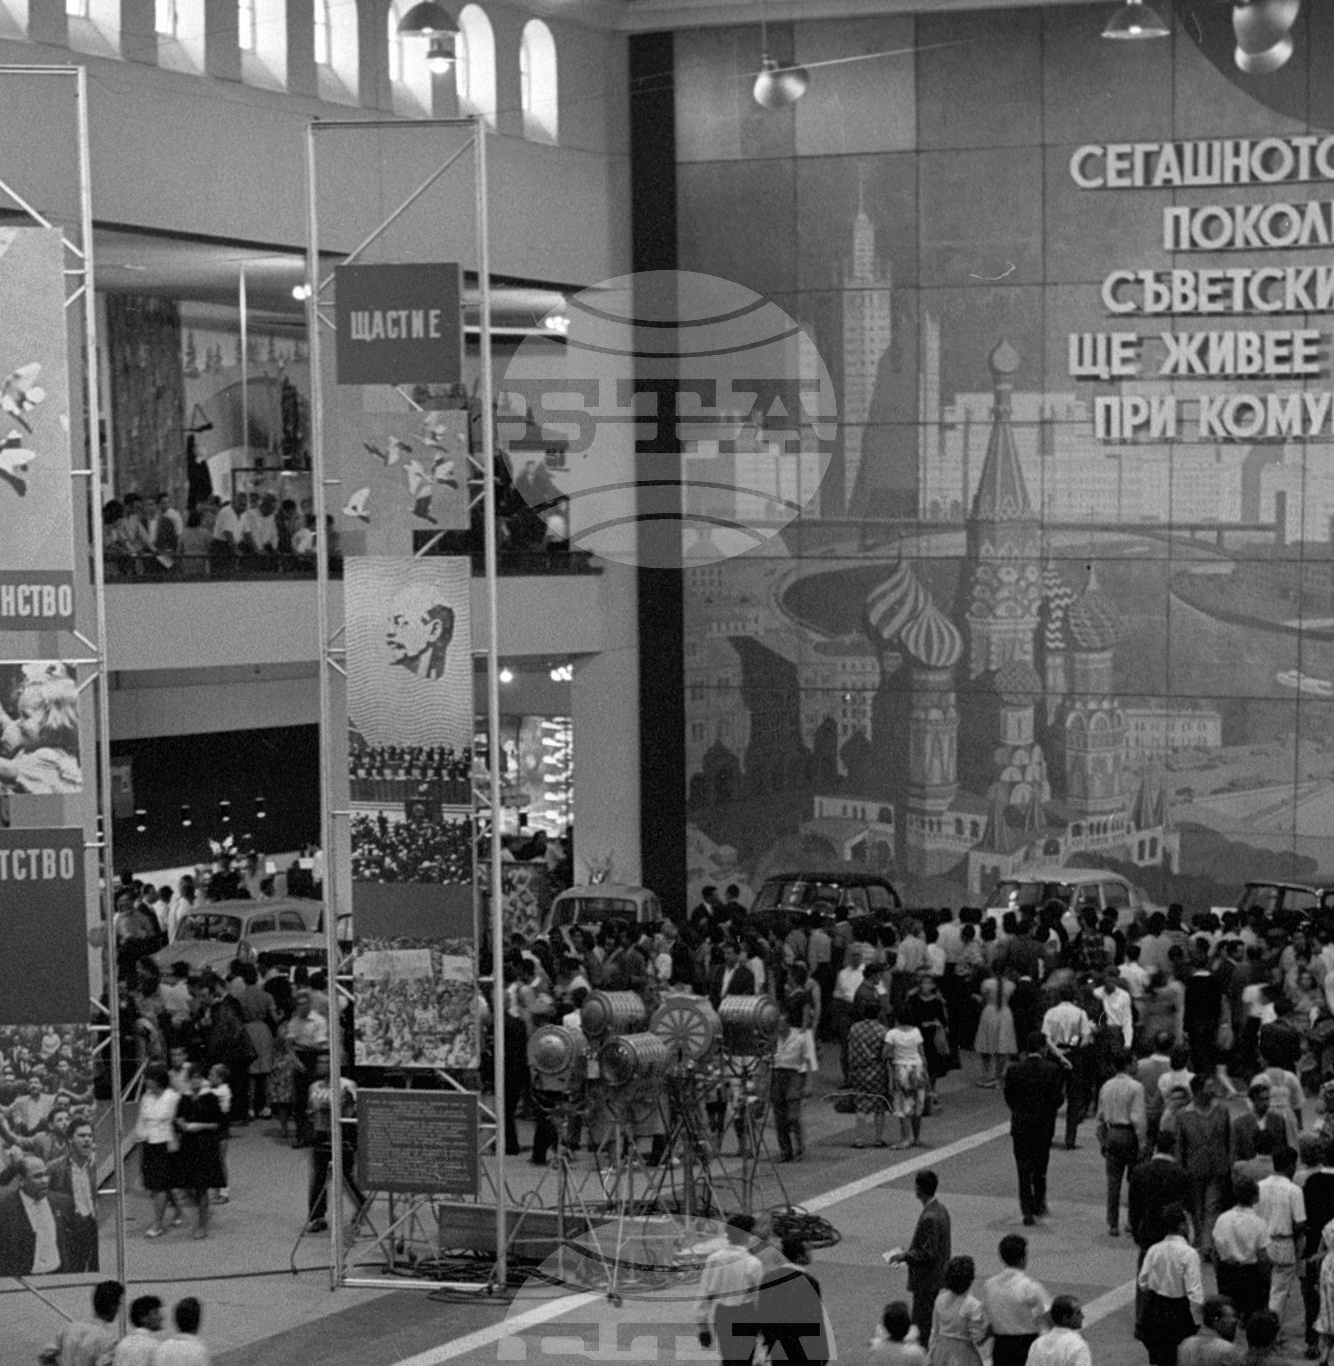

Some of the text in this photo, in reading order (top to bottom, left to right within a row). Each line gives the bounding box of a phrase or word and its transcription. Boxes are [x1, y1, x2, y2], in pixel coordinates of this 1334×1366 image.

[351, 309, 441, 341] ЩАСТИЕ
[1069, 329, 1320, 379] ЩЕ ЖИВЕЕ
[1095, 395, 1177, 439] ПРИ
